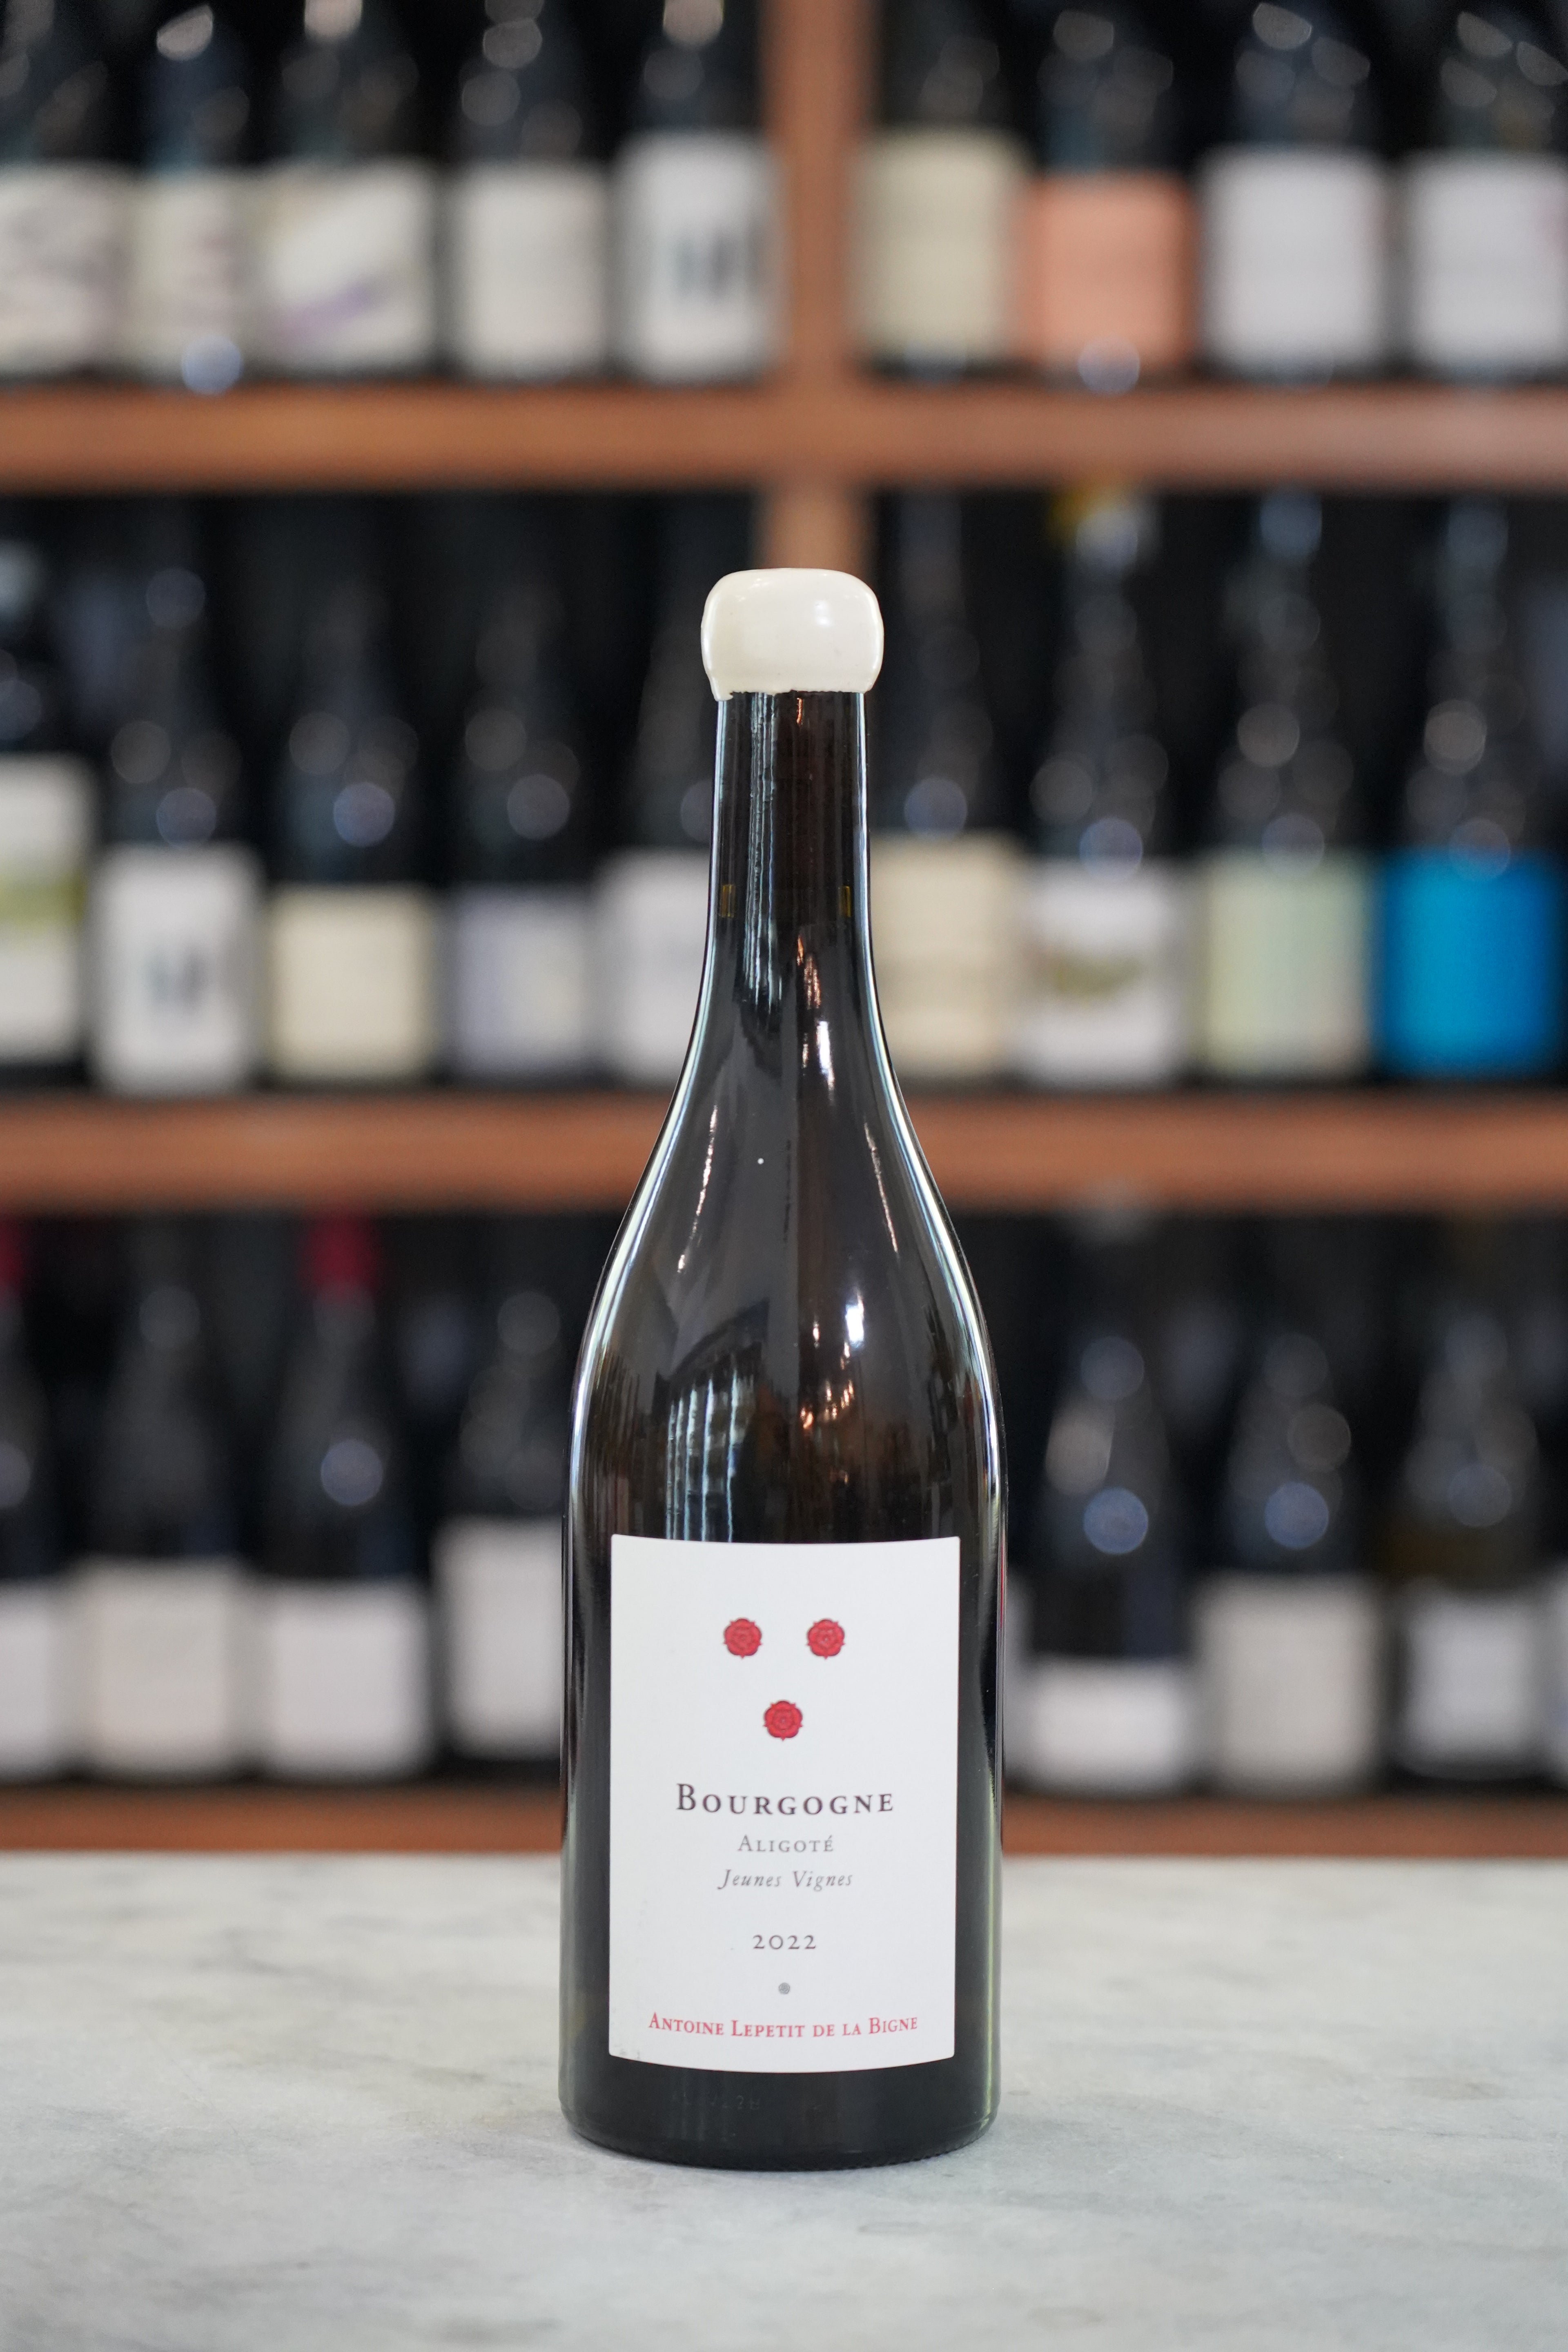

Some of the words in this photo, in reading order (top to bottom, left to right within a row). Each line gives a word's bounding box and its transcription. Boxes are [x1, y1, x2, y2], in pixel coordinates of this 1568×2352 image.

[676, 1783, 893, 1815] BOURGOGNE
[737, 1835, 833, 1853] ALIGOTÉ
[717, 1869, 781, 1890] Jeunes
[793, 1871, 852, 1891] Vignes
[753, 1934, 816, 1950] 2022
[648, 2012, 724, 2035] ANTOINE
[731, 2020, 805, 2038] LEPETIT
[813, 2025, 835, 2037] DE
[842, 2023, 862, 2036] LA
[869, 2017, 917, 2034] BIGNE
